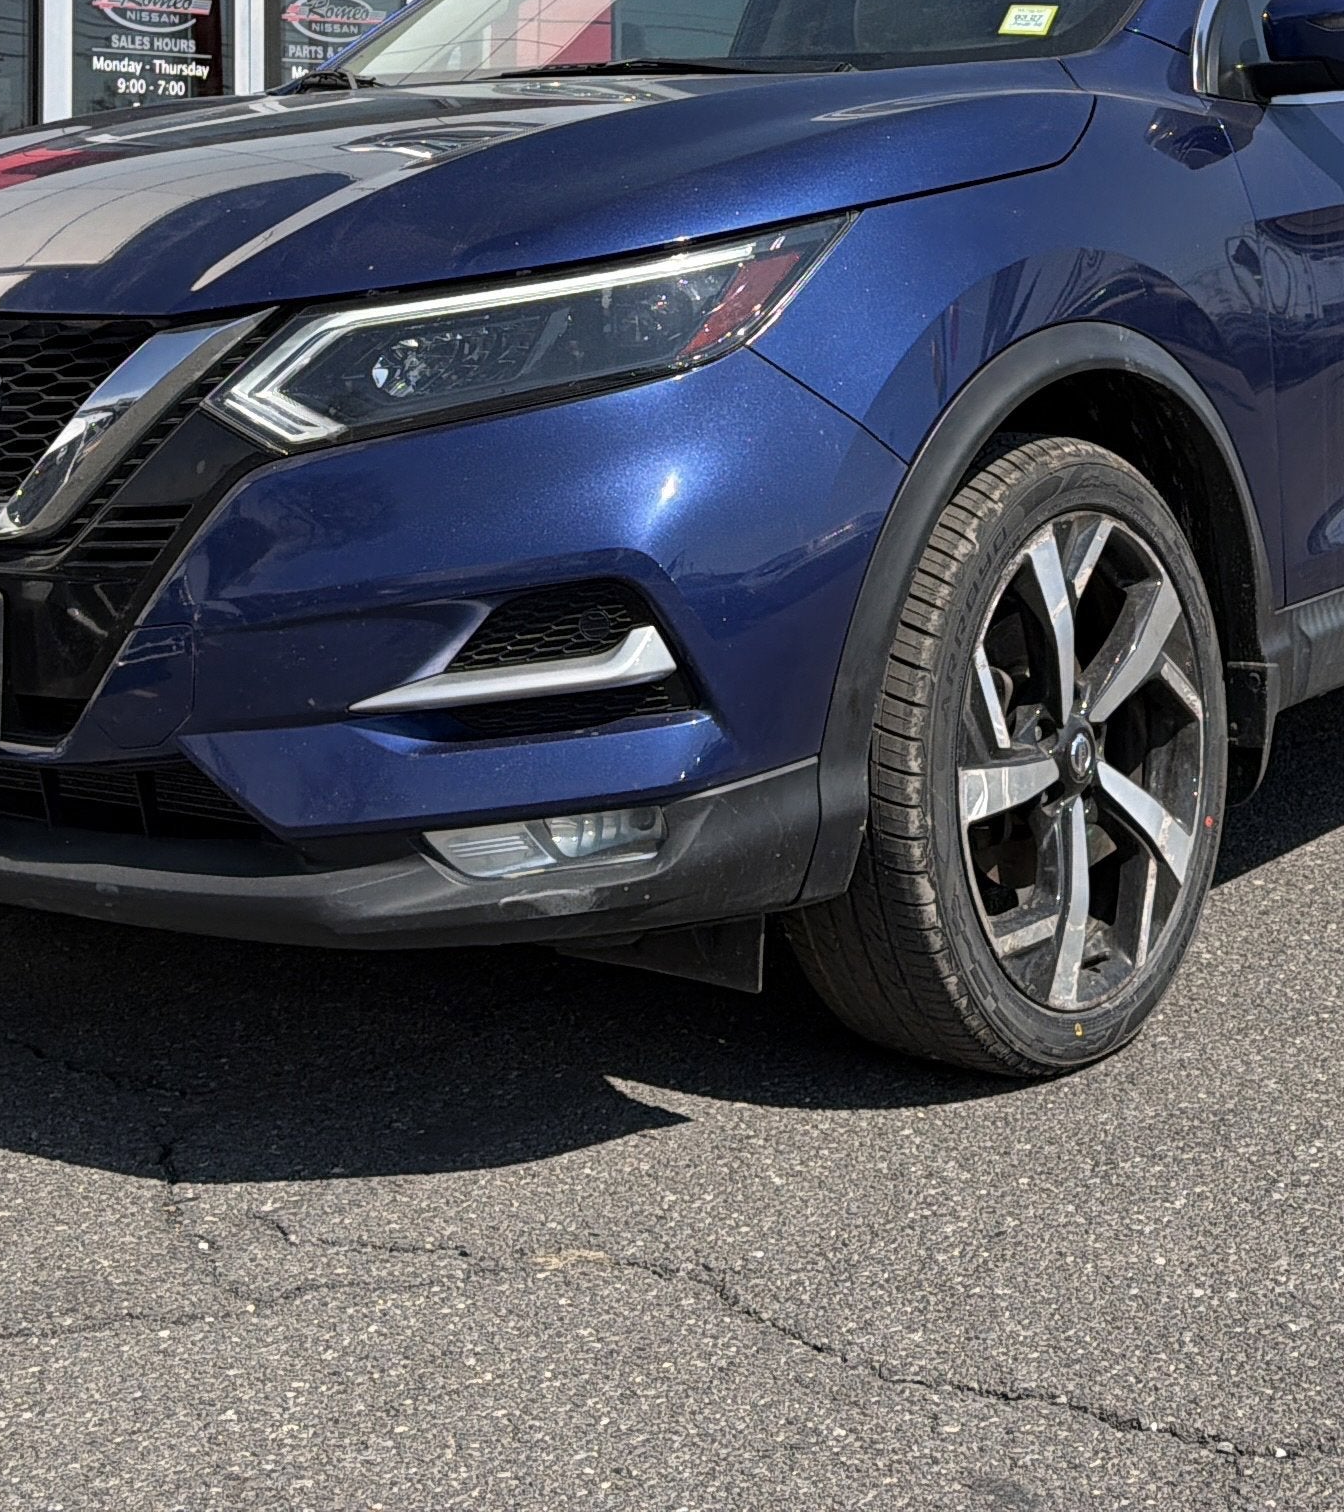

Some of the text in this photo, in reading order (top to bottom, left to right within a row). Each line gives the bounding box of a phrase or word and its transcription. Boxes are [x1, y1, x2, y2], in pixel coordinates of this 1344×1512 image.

[126, 11, 180, 24] NISSAN
[311, 23, 359, 34] NISSAN
[111, 34, 196, 53] SALES HOURS
[288, 45, 323, 59] PARTS
[92, 56, 143, 76] Monday
[153, 59, 210, 80] Thursday
[117, 78, 146, 94] 9:00
[157, 80, 186, 96] 7:00
